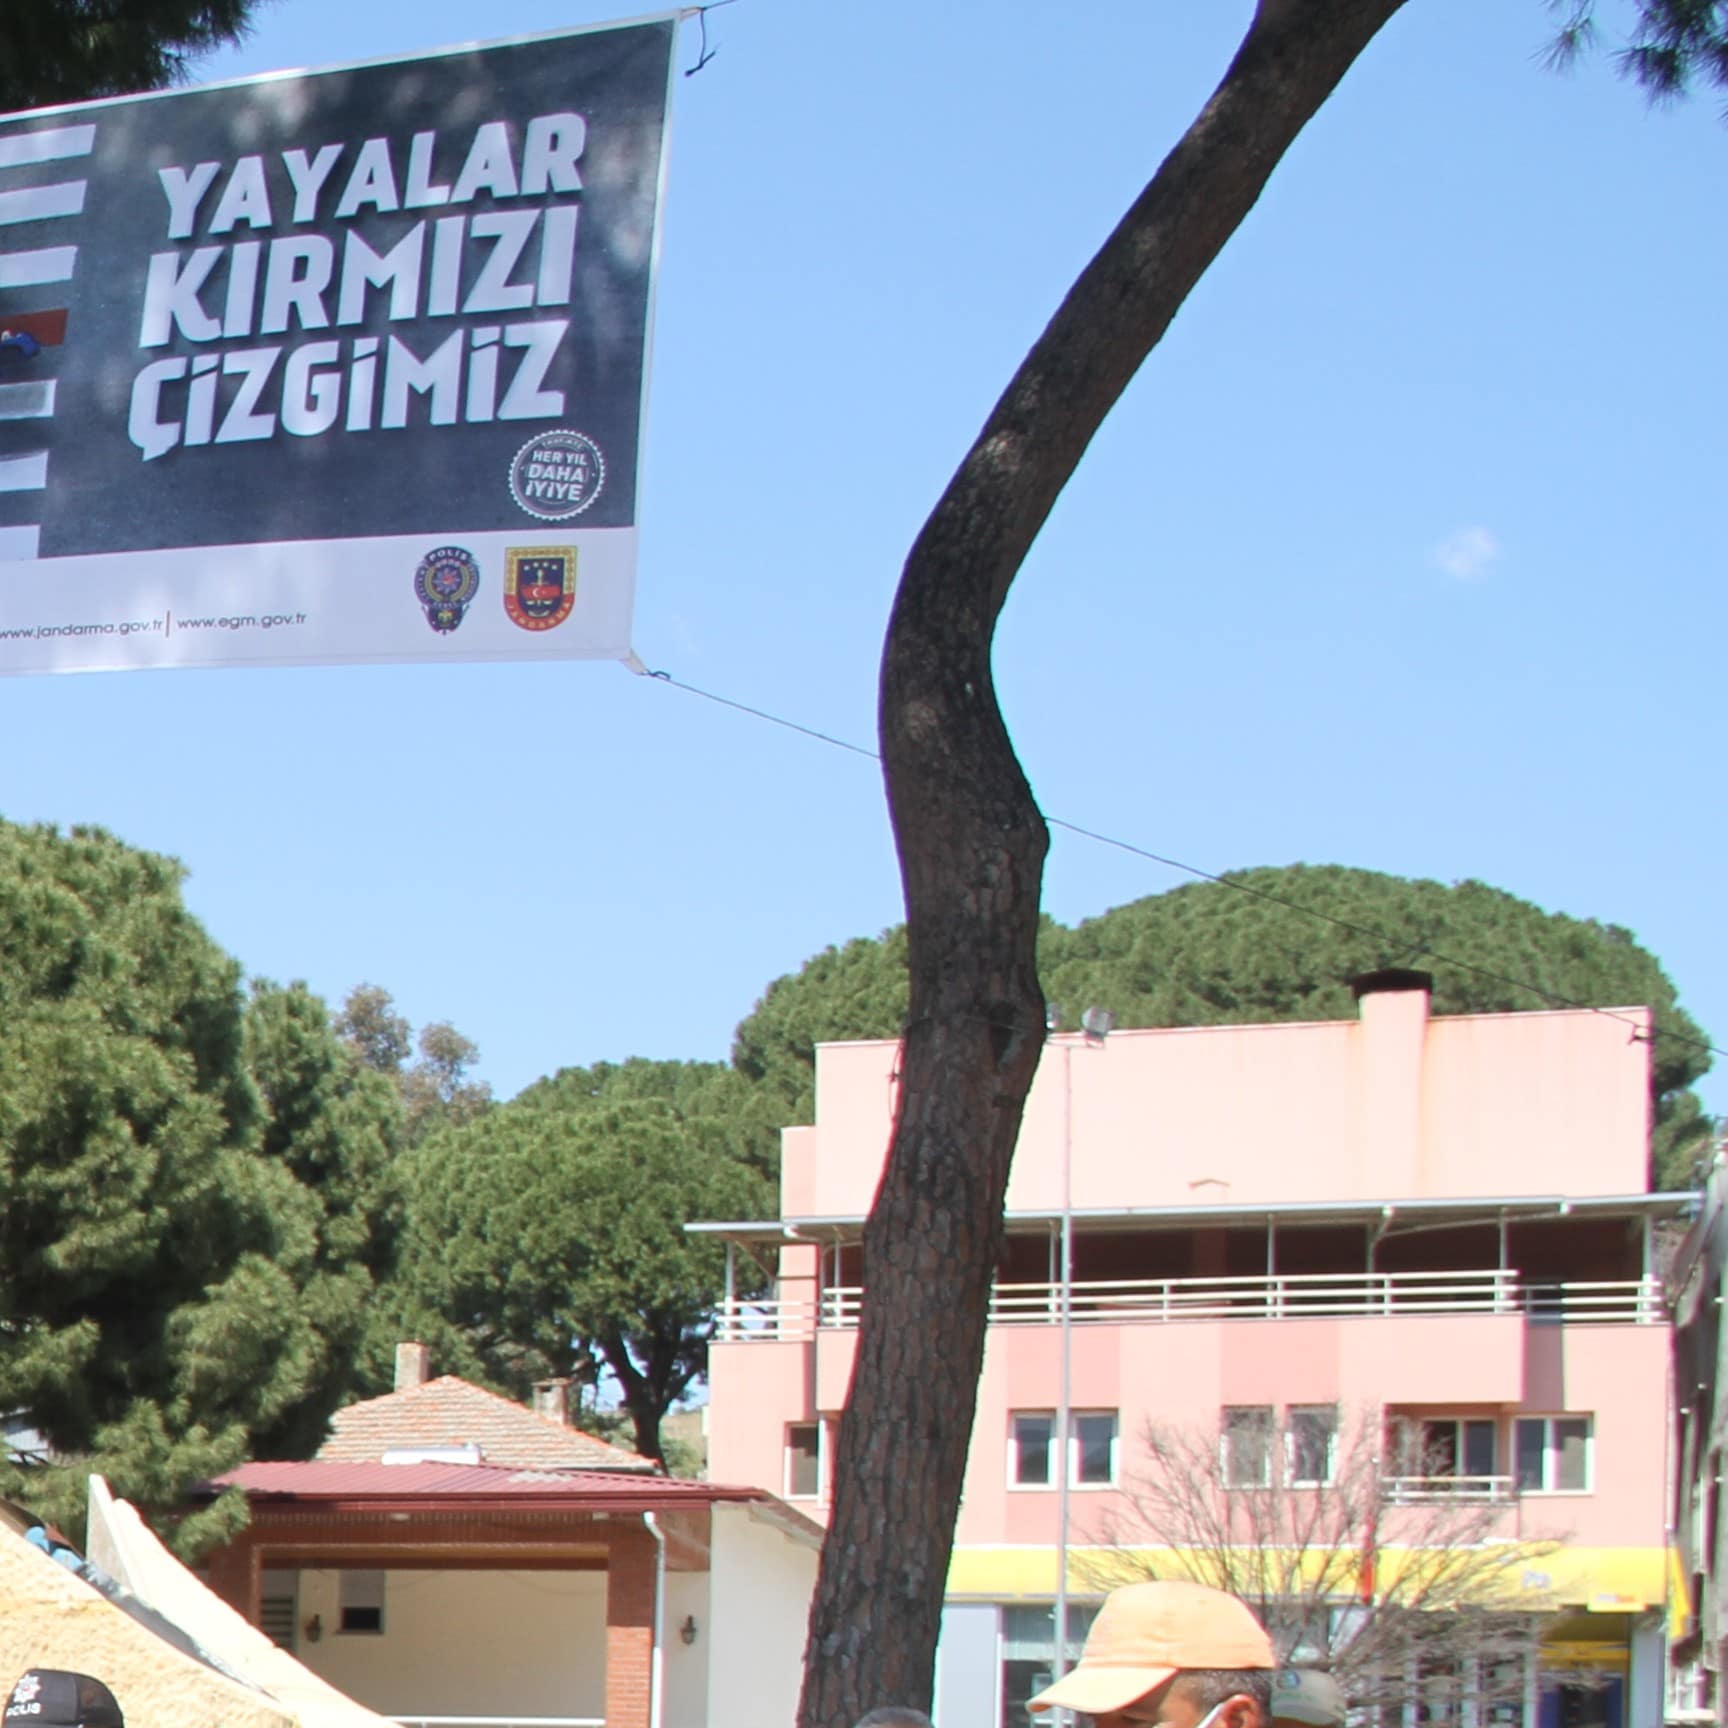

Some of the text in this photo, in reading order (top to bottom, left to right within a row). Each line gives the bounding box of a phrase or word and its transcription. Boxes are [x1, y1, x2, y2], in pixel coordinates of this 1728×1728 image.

[157, 112, 587, 240] YAYALAR
[138, 204, 579, 349] KIRMIZI
[127, 320, 571, 462] ÇİZGİMİZ
[532, 450, 588, 466] HER YIL
[527, 463, 585, 483] DAHA
[525, 479, 584, 502] İYİYE
[176, 611, 307, 630] www.egm.gov.tr
